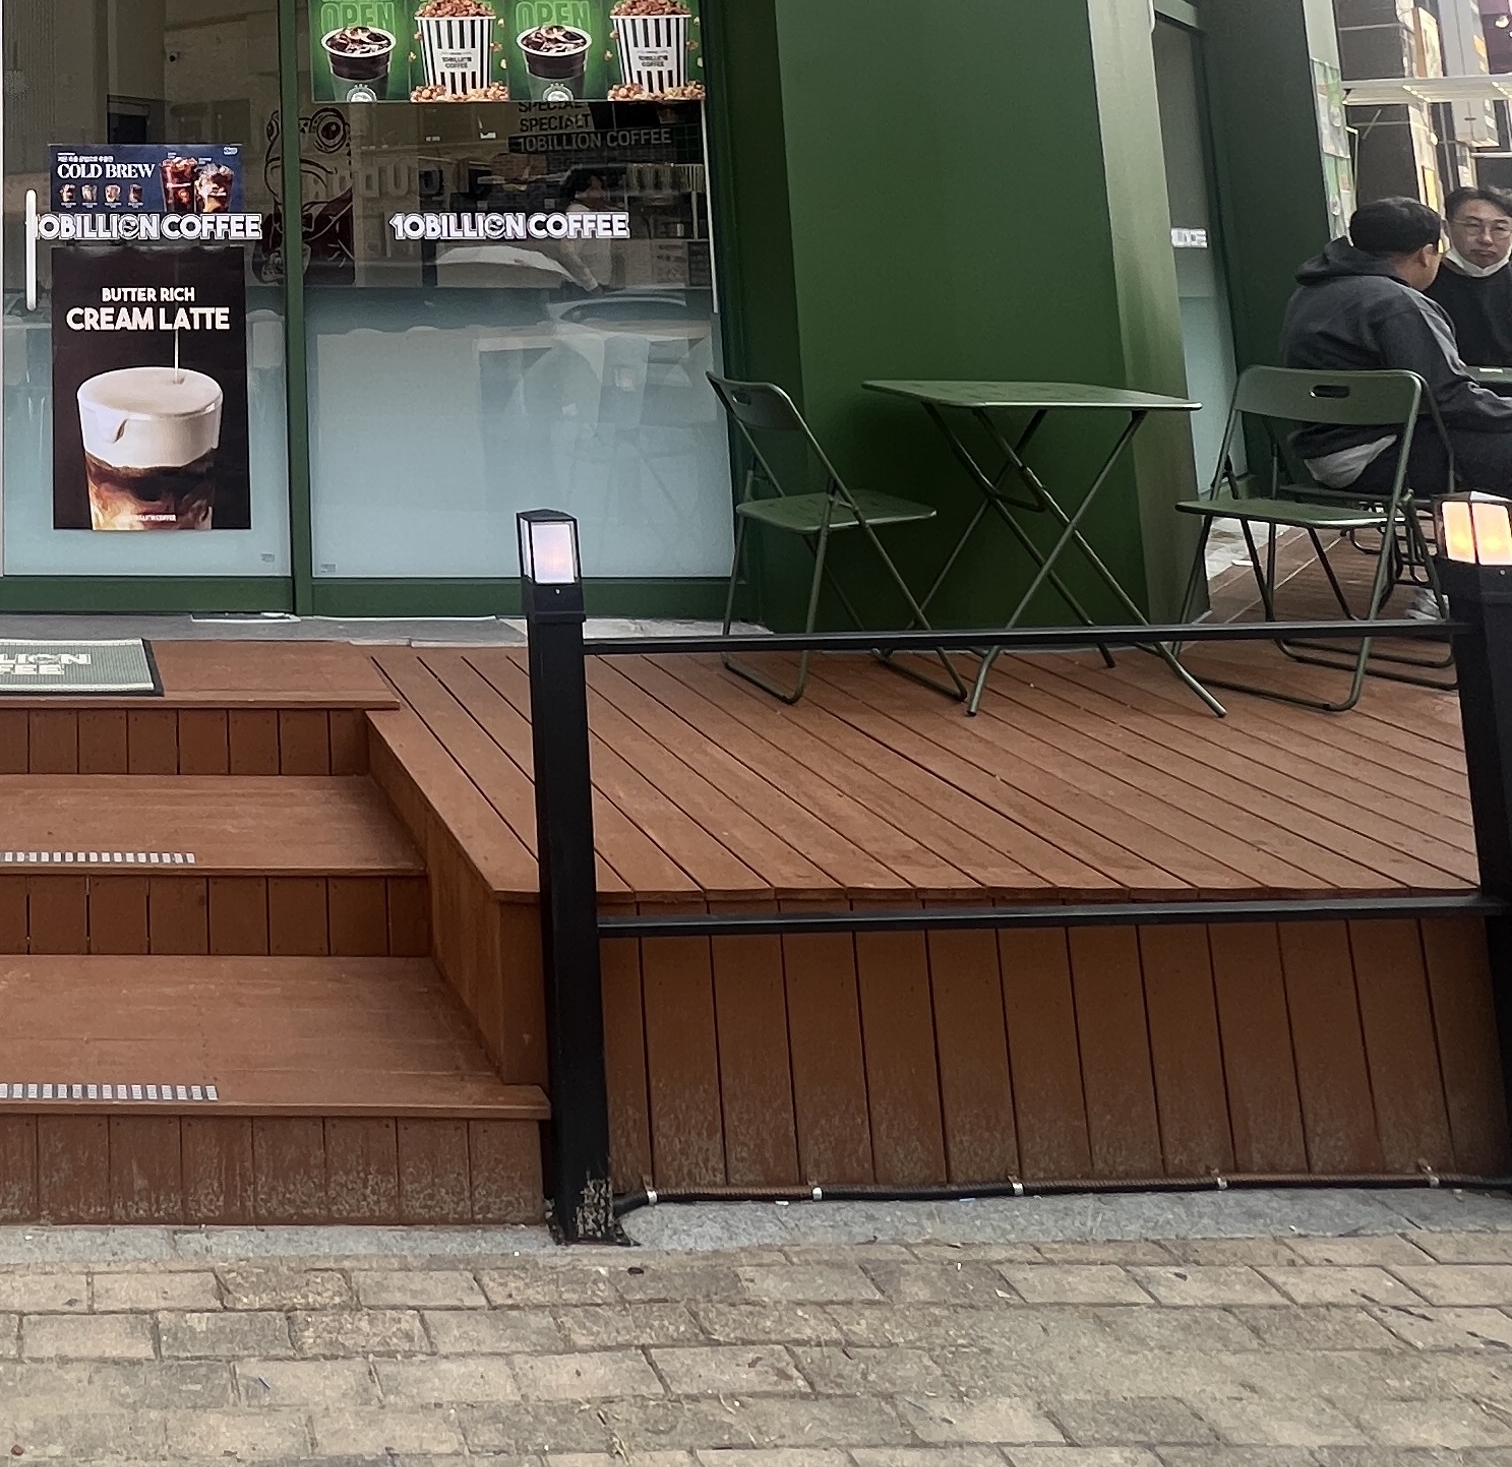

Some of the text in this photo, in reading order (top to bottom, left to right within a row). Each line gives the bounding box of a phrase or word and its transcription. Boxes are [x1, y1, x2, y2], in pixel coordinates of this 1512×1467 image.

[519, 128, 672, 152] 10BILLION COFFEE
[57, 163, 157, 179] COLD BREW
[28, 213, 263, 240] 0BILLION COFFEE
[389, 212, 630, 240] 10BILLION COFFEE
[101, 287, 195, 302] BUTTER RICH
[66, 306, 230, 331] CREAM LATTE
